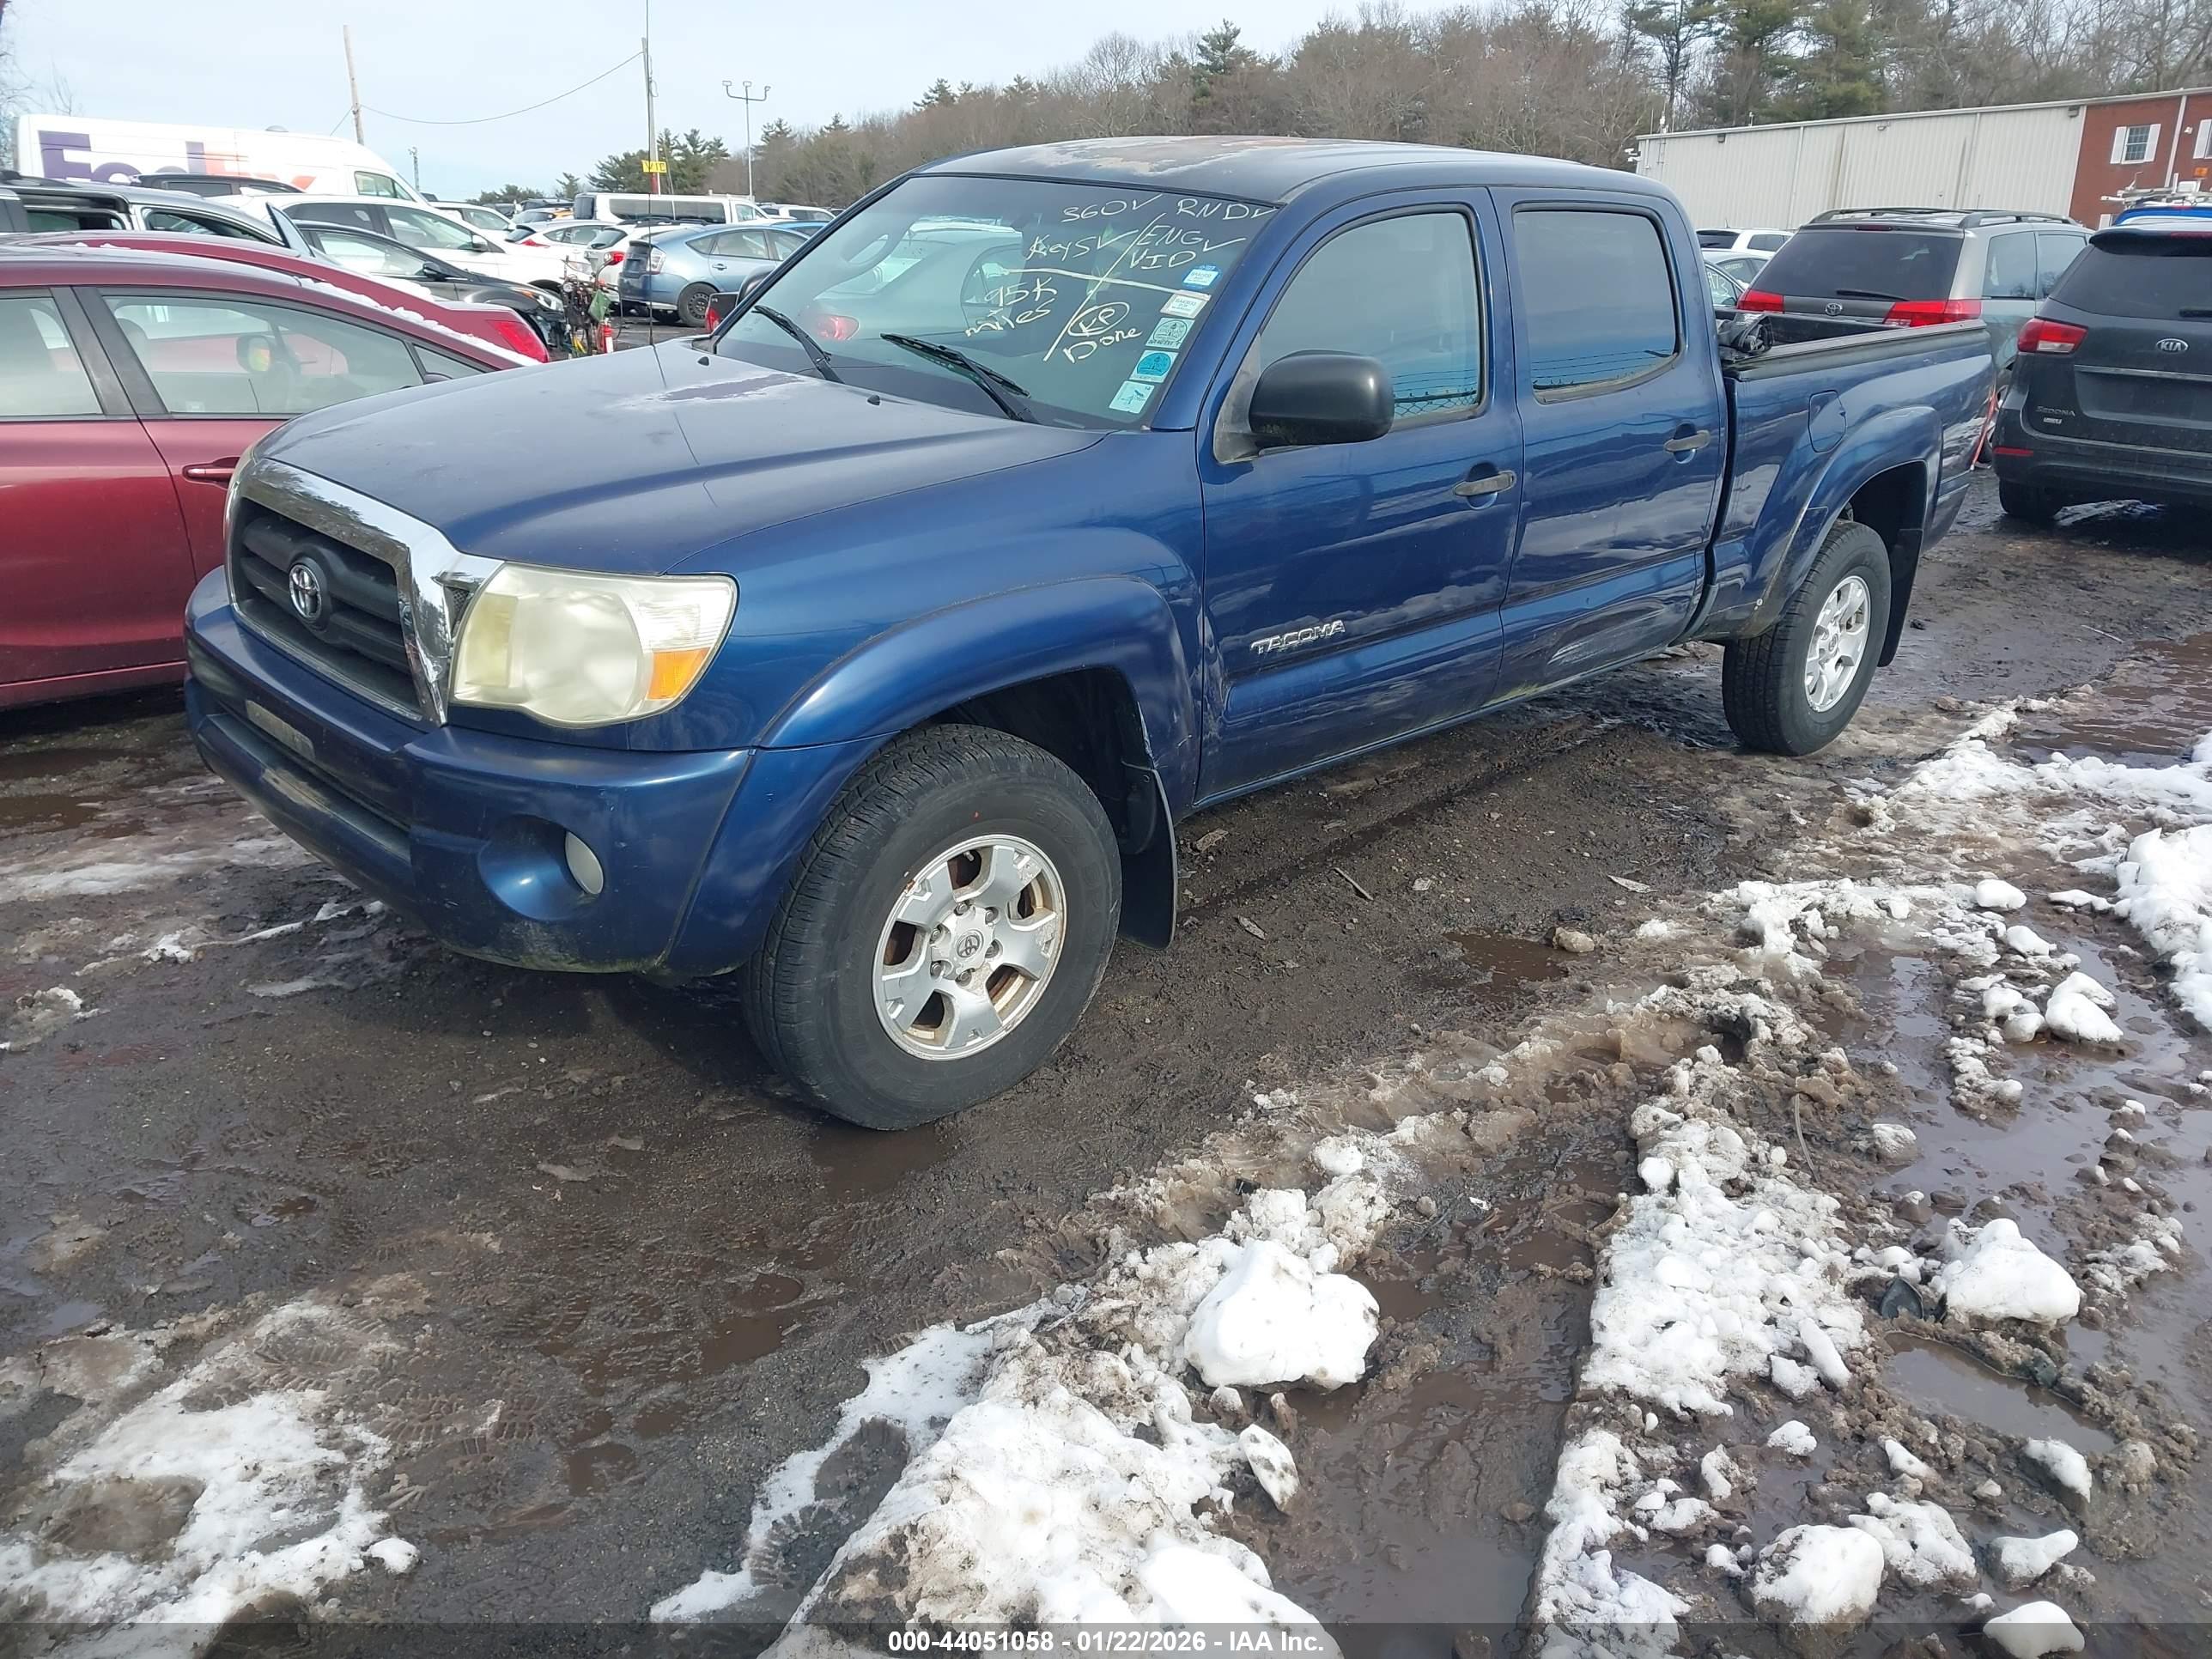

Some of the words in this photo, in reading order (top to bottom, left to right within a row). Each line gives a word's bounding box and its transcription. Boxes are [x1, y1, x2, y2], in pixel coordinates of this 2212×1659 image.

[1138, 224, 1202, 246] ENG
[1129, 249, 1197, 270] VID
[964, 298, 1055, 337] miles
[1063, 328, 1142, 364] Done
[2160, 341, 2182, 351] KIA
[1250, 620, 1346, 654] TACOMA
